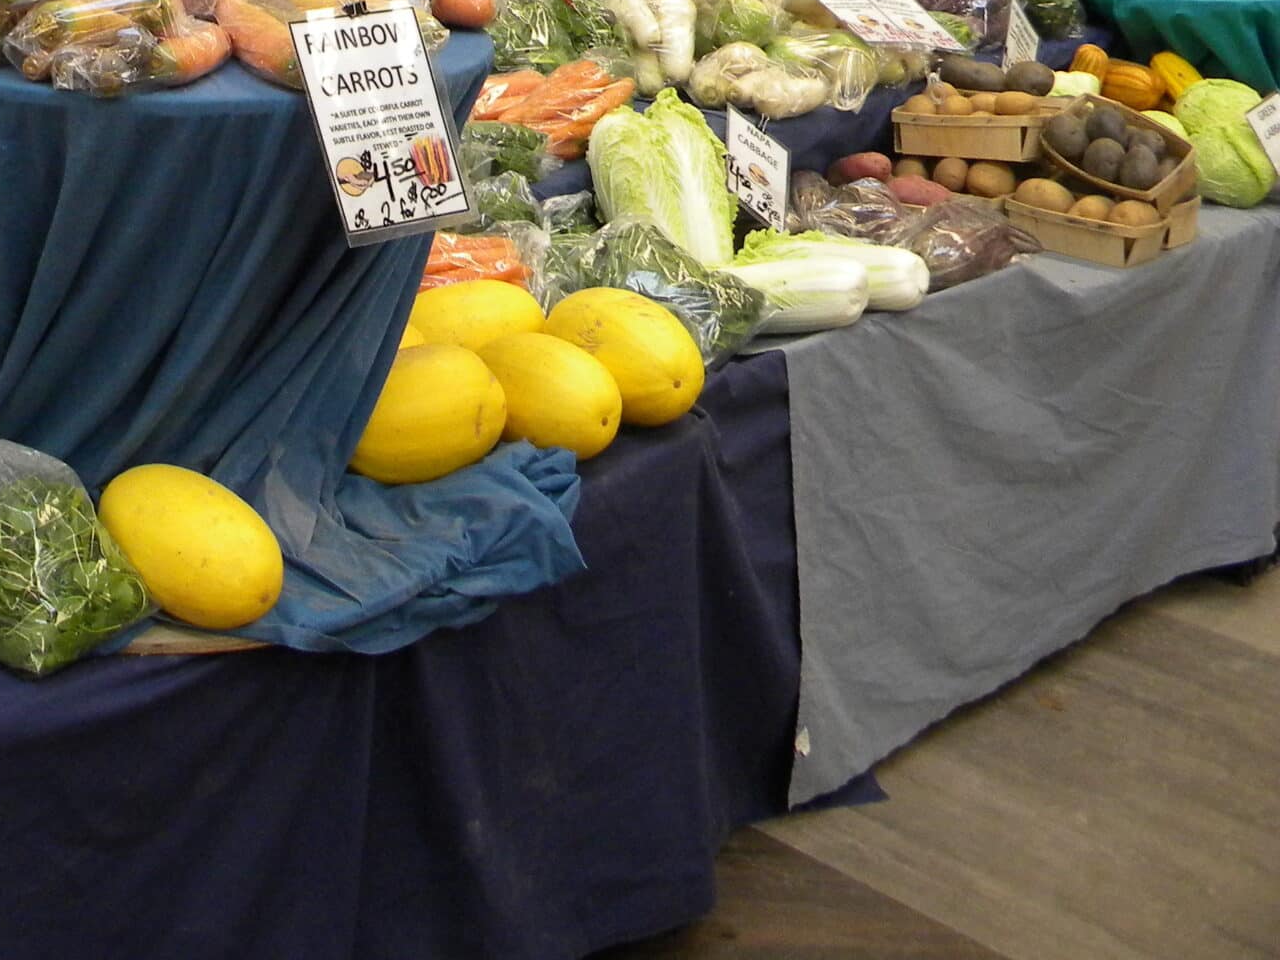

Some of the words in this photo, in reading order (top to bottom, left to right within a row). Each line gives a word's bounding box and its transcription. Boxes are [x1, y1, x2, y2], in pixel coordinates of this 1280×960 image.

[321, 63, 419, 97] CARROTS
[358, 107, 368, 116] OF
[400, 98, 423, 109] CARROT
[414, 110, 431, 120] OWN
[399, 123, 425, 134] ROASTED
[424, 121, 435, 130] OR
[737, 133, 780, 171] CABBAGE
